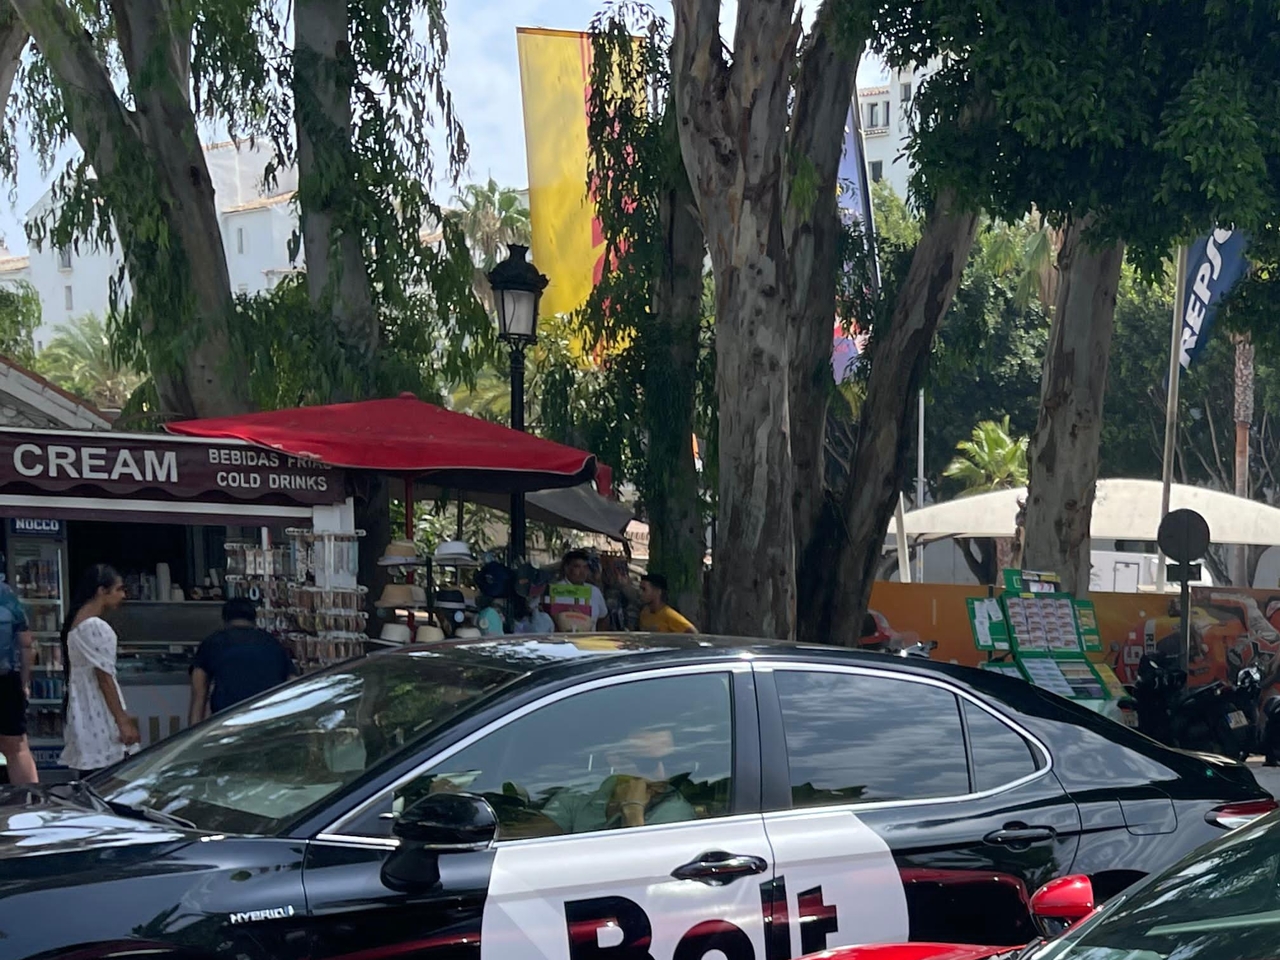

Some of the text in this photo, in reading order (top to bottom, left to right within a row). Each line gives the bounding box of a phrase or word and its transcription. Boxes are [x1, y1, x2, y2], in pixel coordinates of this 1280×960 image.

[13, 443, 179, 483] CREAM
[208, 448, 280, 467] BEBIDAS
[216, 471, 328, 492] COLD DRINKS
[15, 517, 60, 531] NOCCO
[229, 907, 285, 924] HYBRID
